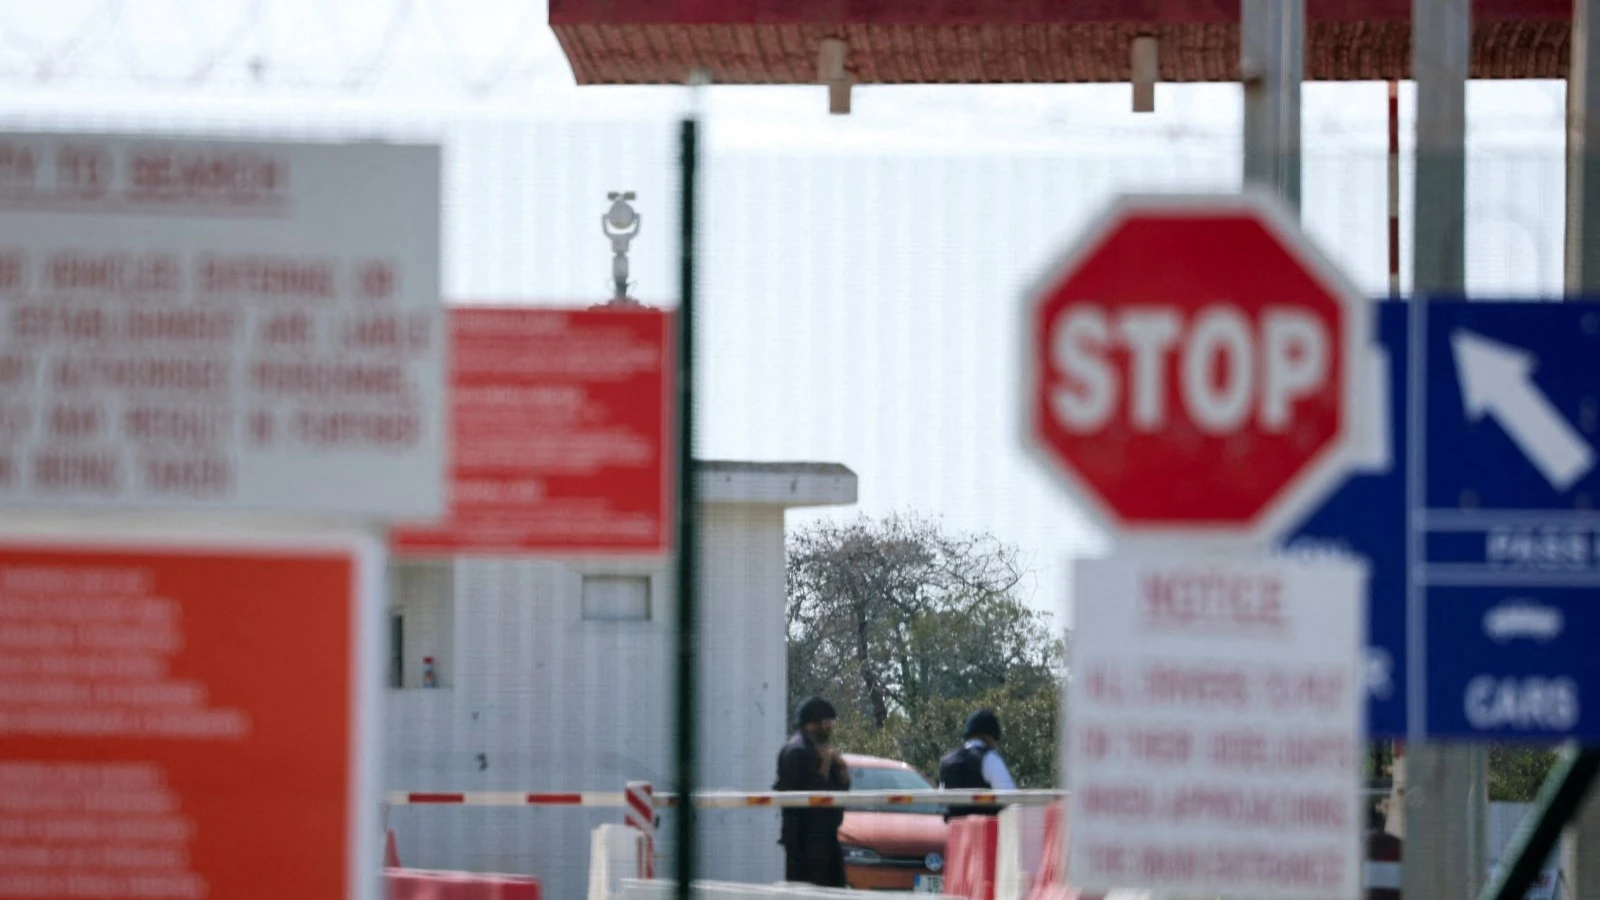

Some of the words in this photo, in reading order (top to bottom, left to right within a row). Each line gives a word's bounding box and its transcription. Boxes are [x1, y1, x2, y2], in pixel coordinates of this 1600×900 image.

[1051, 304, 1330, 432] STOP
[1486, 528, 1587, 570] PASS
[1139, 570, 1286, 618] NOTICE
[1464, 675, 1580, 730] CARS
